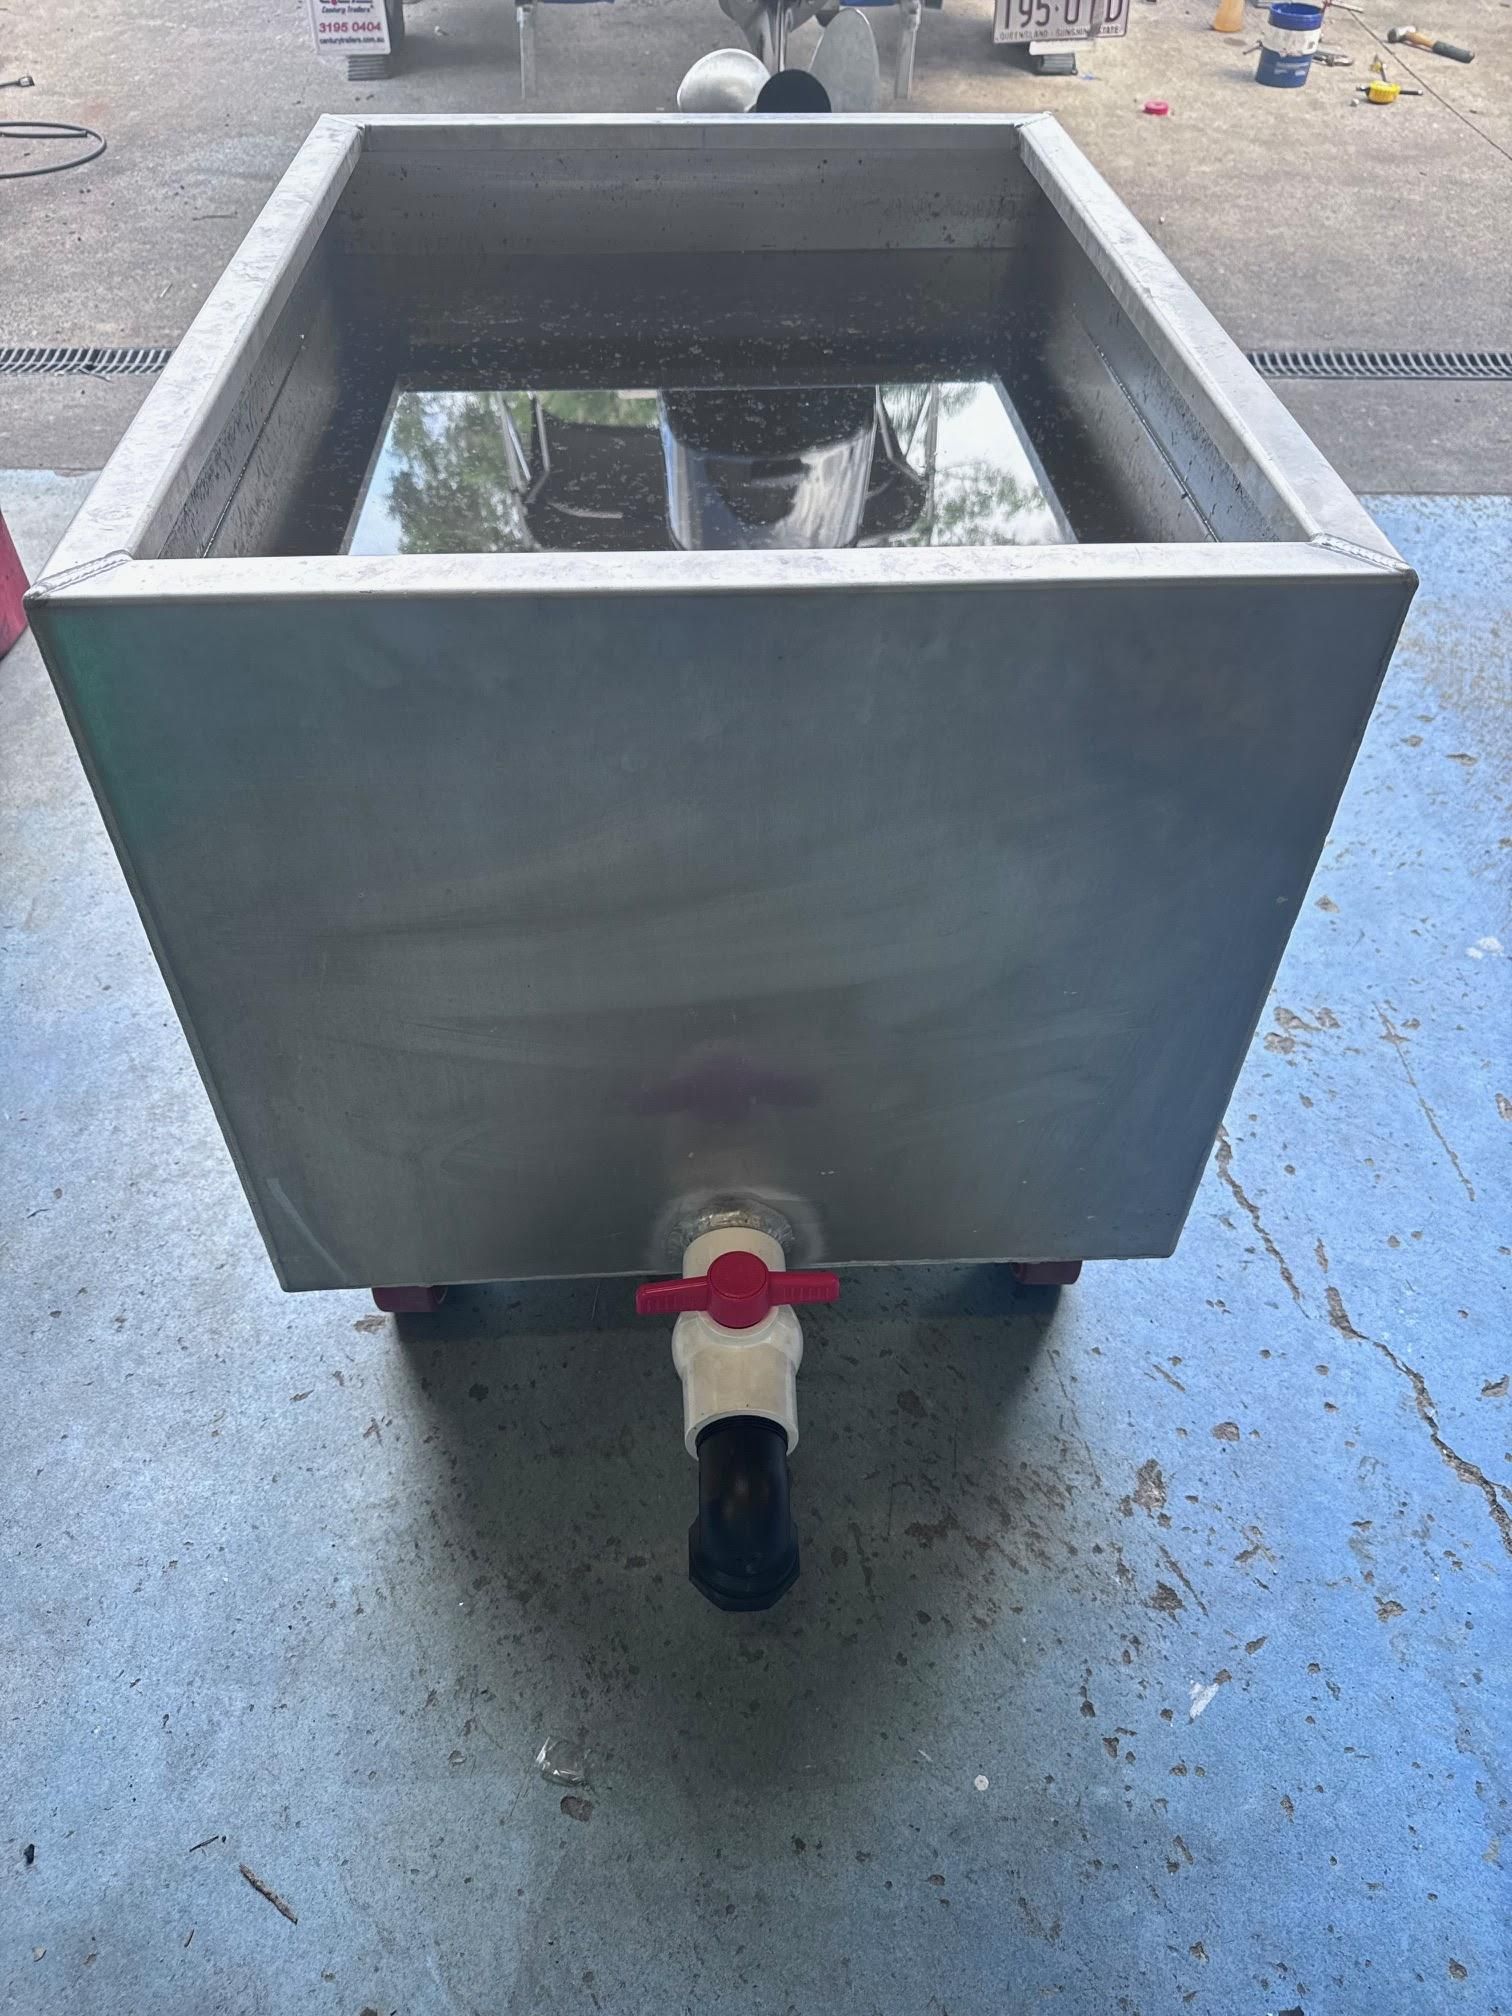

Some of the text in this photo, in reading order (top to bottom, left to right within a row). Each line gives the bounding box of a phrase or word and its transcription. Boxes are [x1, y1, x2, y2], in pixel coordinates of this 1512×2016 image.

[319, 21, 381, 33] 3195 0404
[999, 29, 1048, 41] QUEENSLAND
[1056, 25, 1091, 36] SUNSHIN
[319, 36, 384, 44] centurytrailers.com.au
